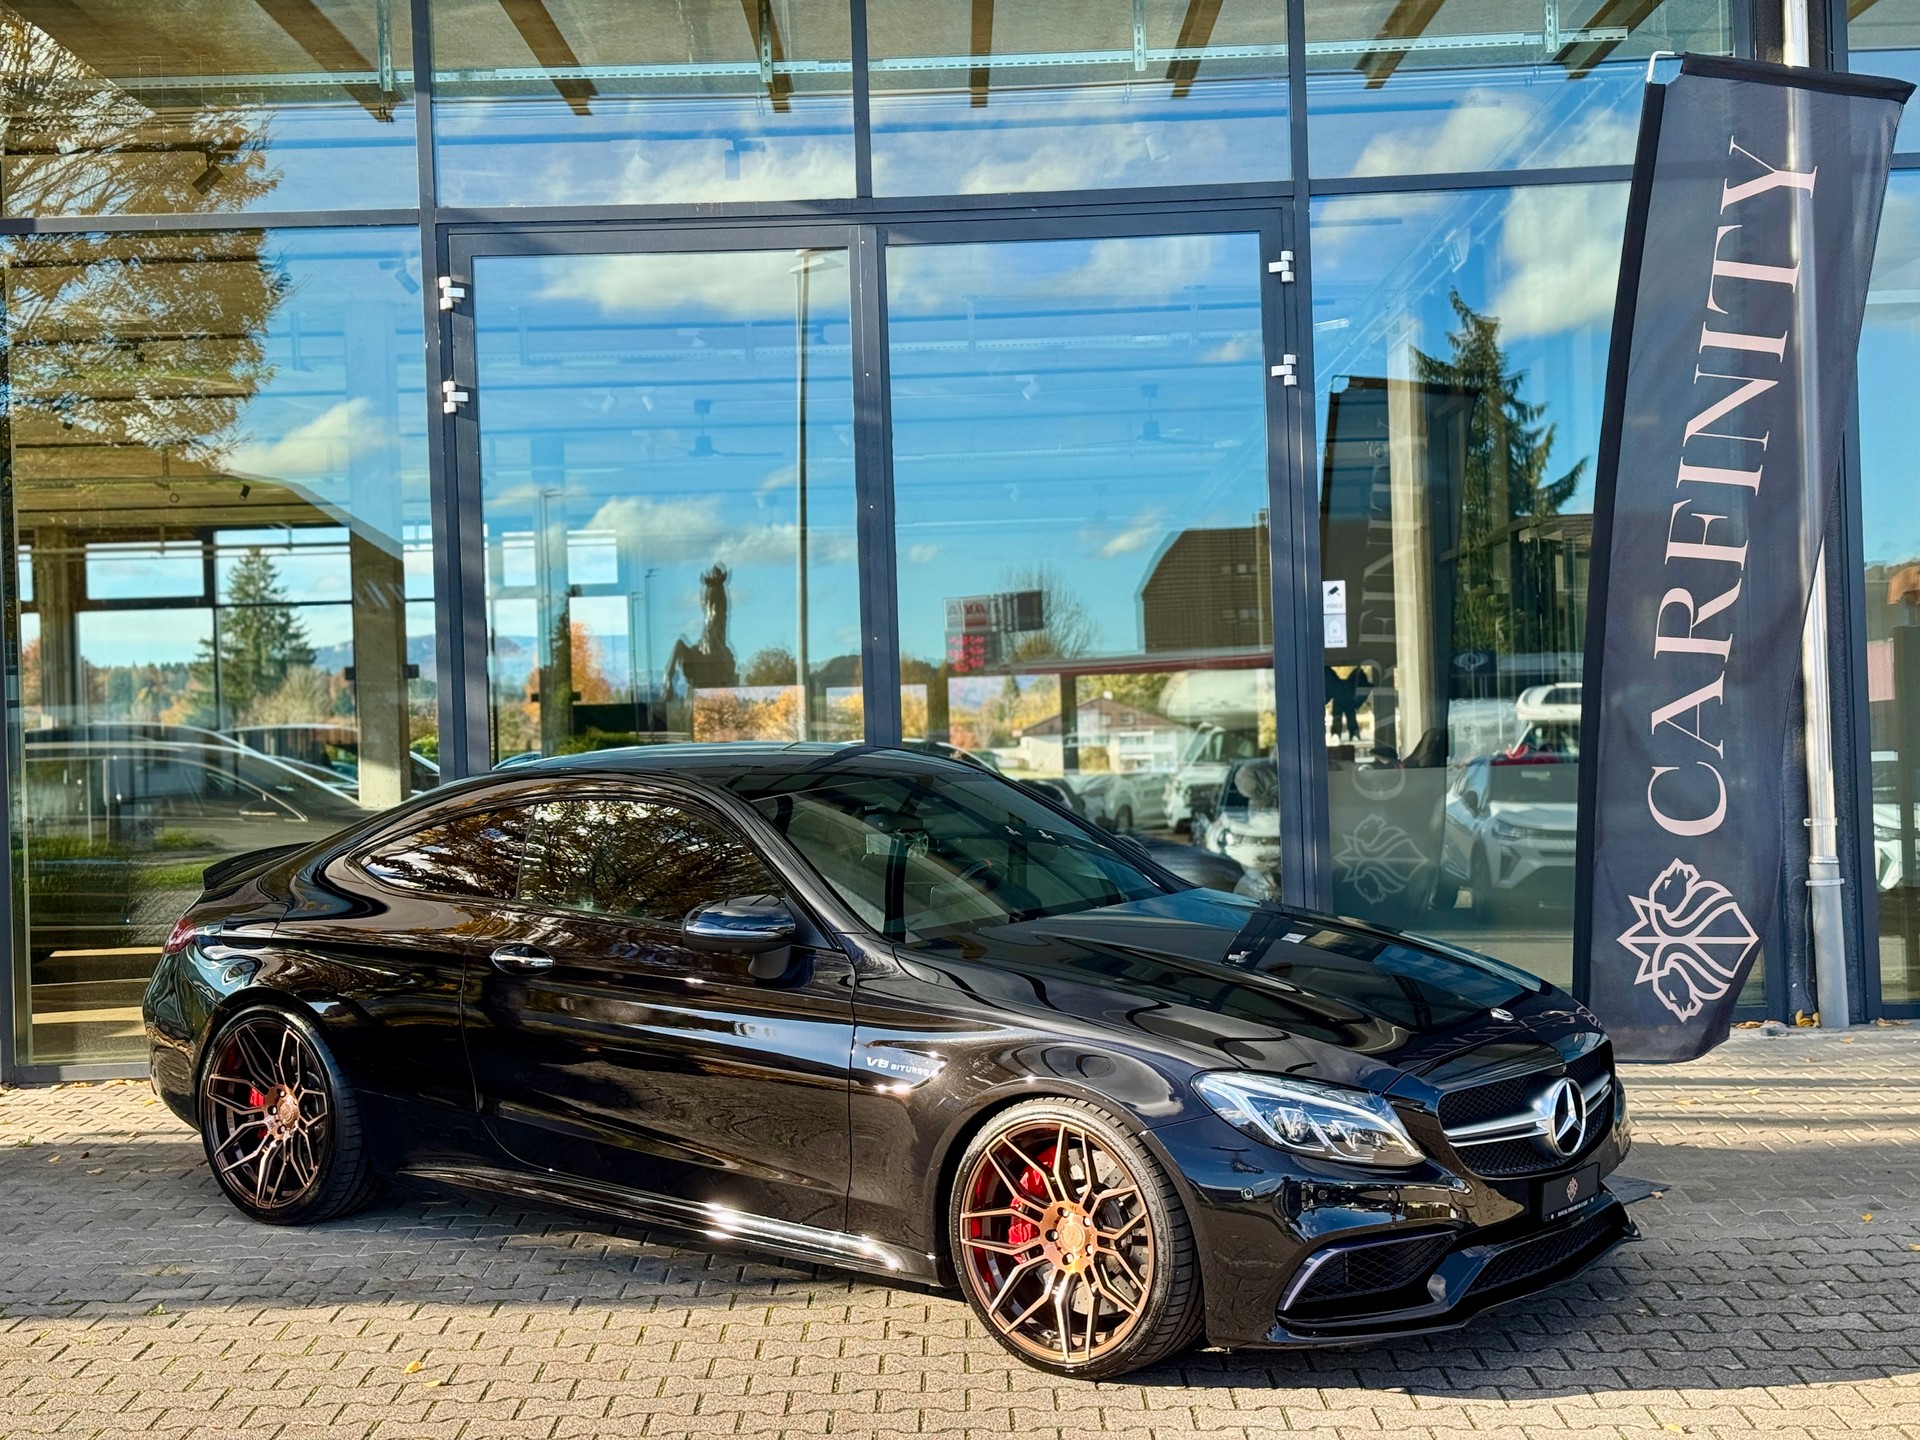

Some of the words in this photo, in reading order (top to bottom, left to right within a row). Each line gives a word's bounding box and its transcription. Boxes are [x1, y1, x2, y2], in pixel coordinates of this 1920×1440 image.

[1648, 134, 1818, 837] CARFINITY
[866, 1056, 890, 1069] V8
[890, 1063, 930, 1076] BITURBO
